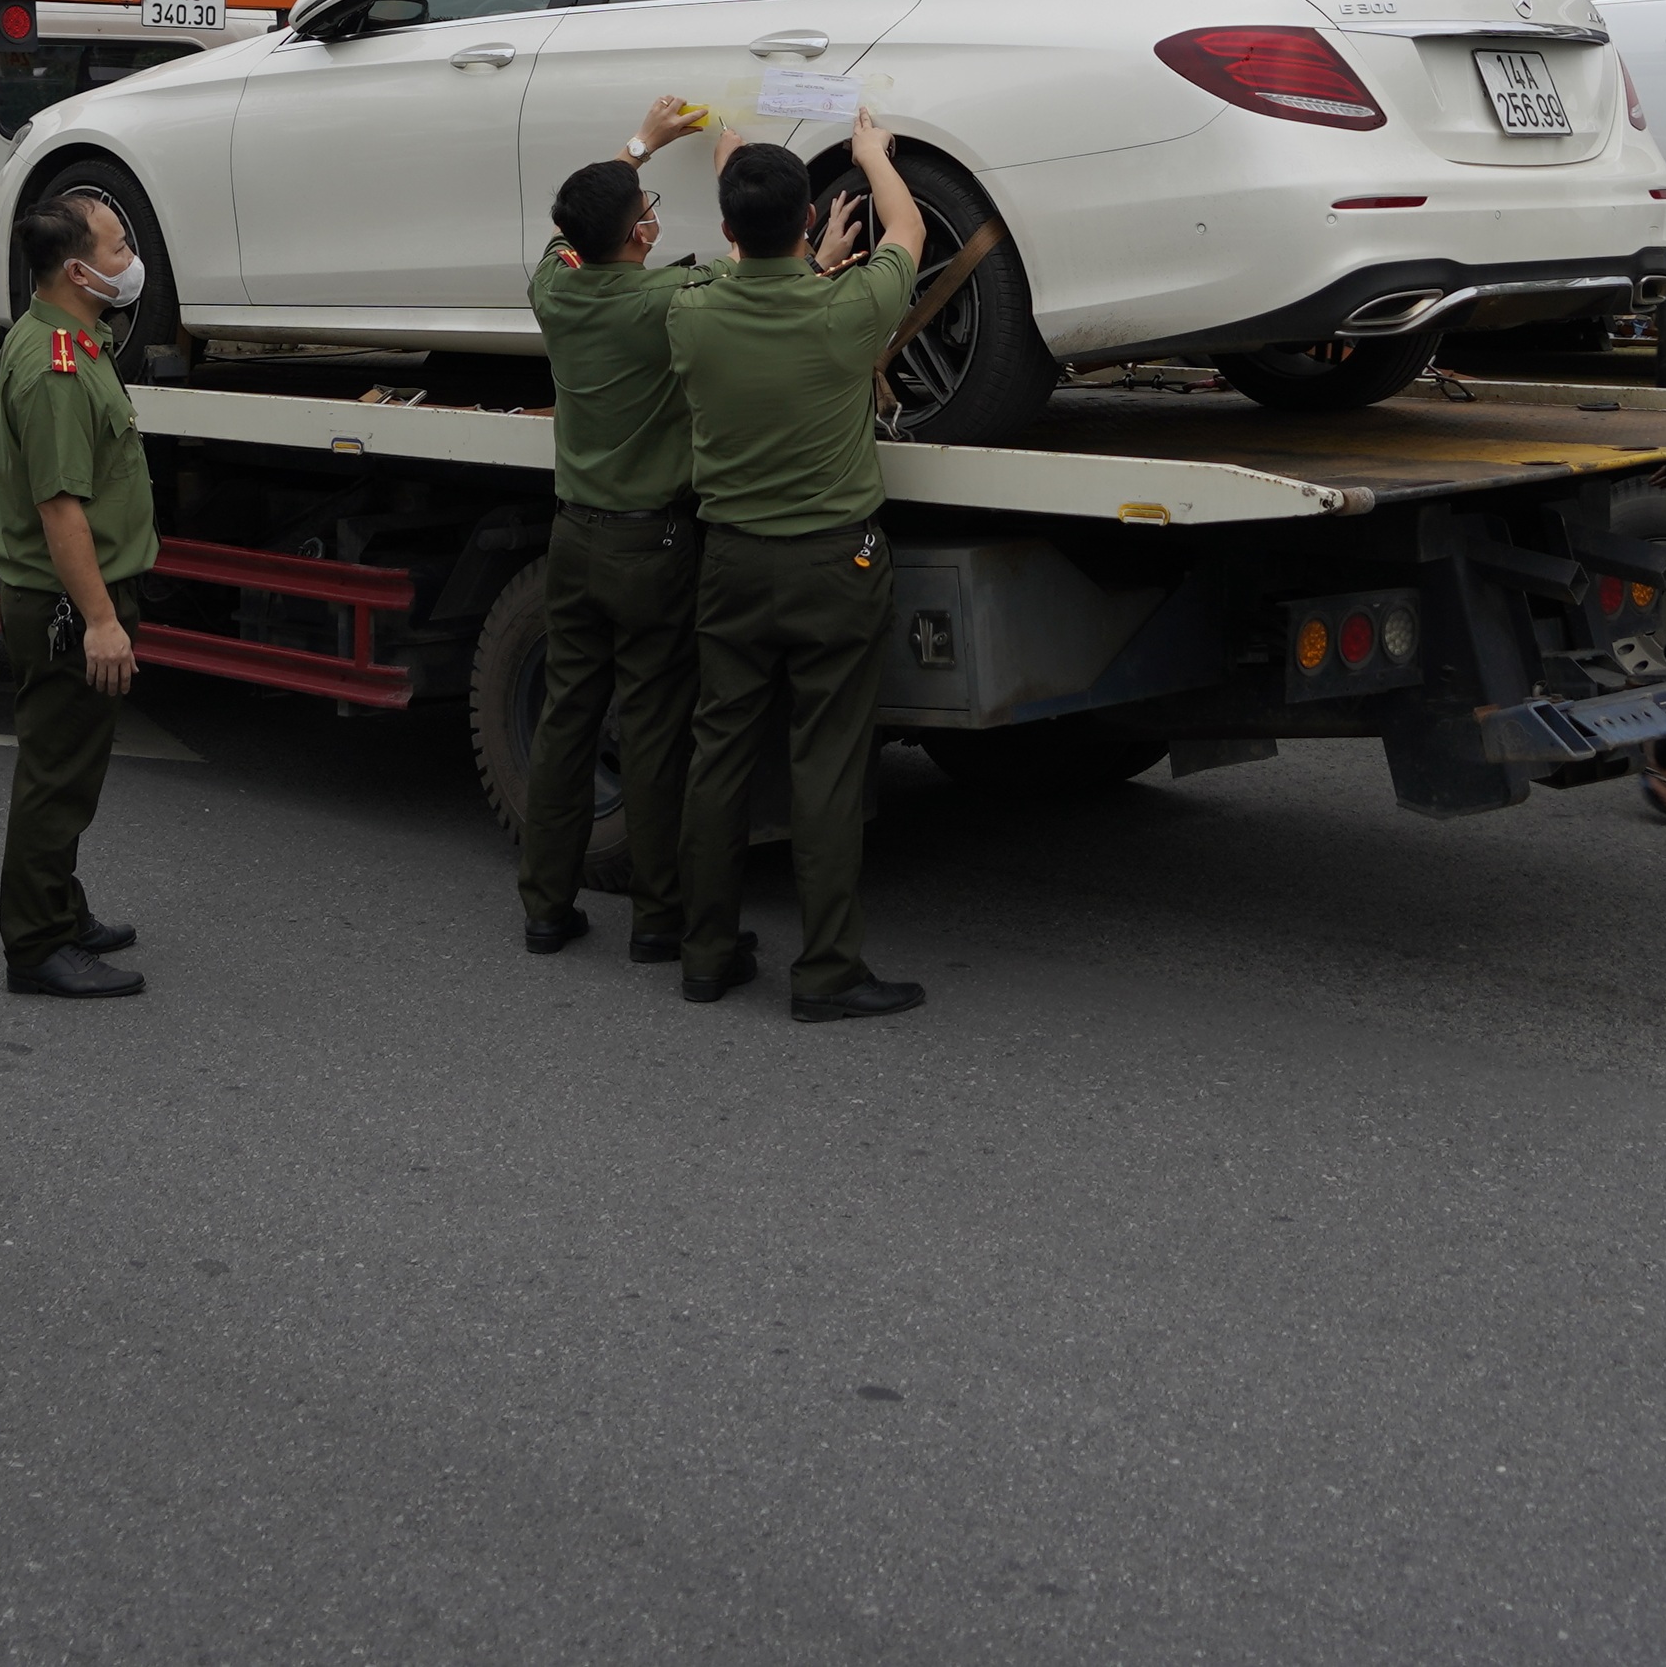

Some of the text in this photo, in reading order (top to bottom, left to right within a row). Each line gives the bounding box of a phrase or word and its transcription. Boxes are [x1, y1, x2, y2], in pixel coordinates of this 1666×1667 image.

[151, 3, 216, 26] 340.30
[1358, 2, 1398, 14] 300
[1496, 54, 1539, 90] 14A
[1497, 92, 1565, 128] 256.99
